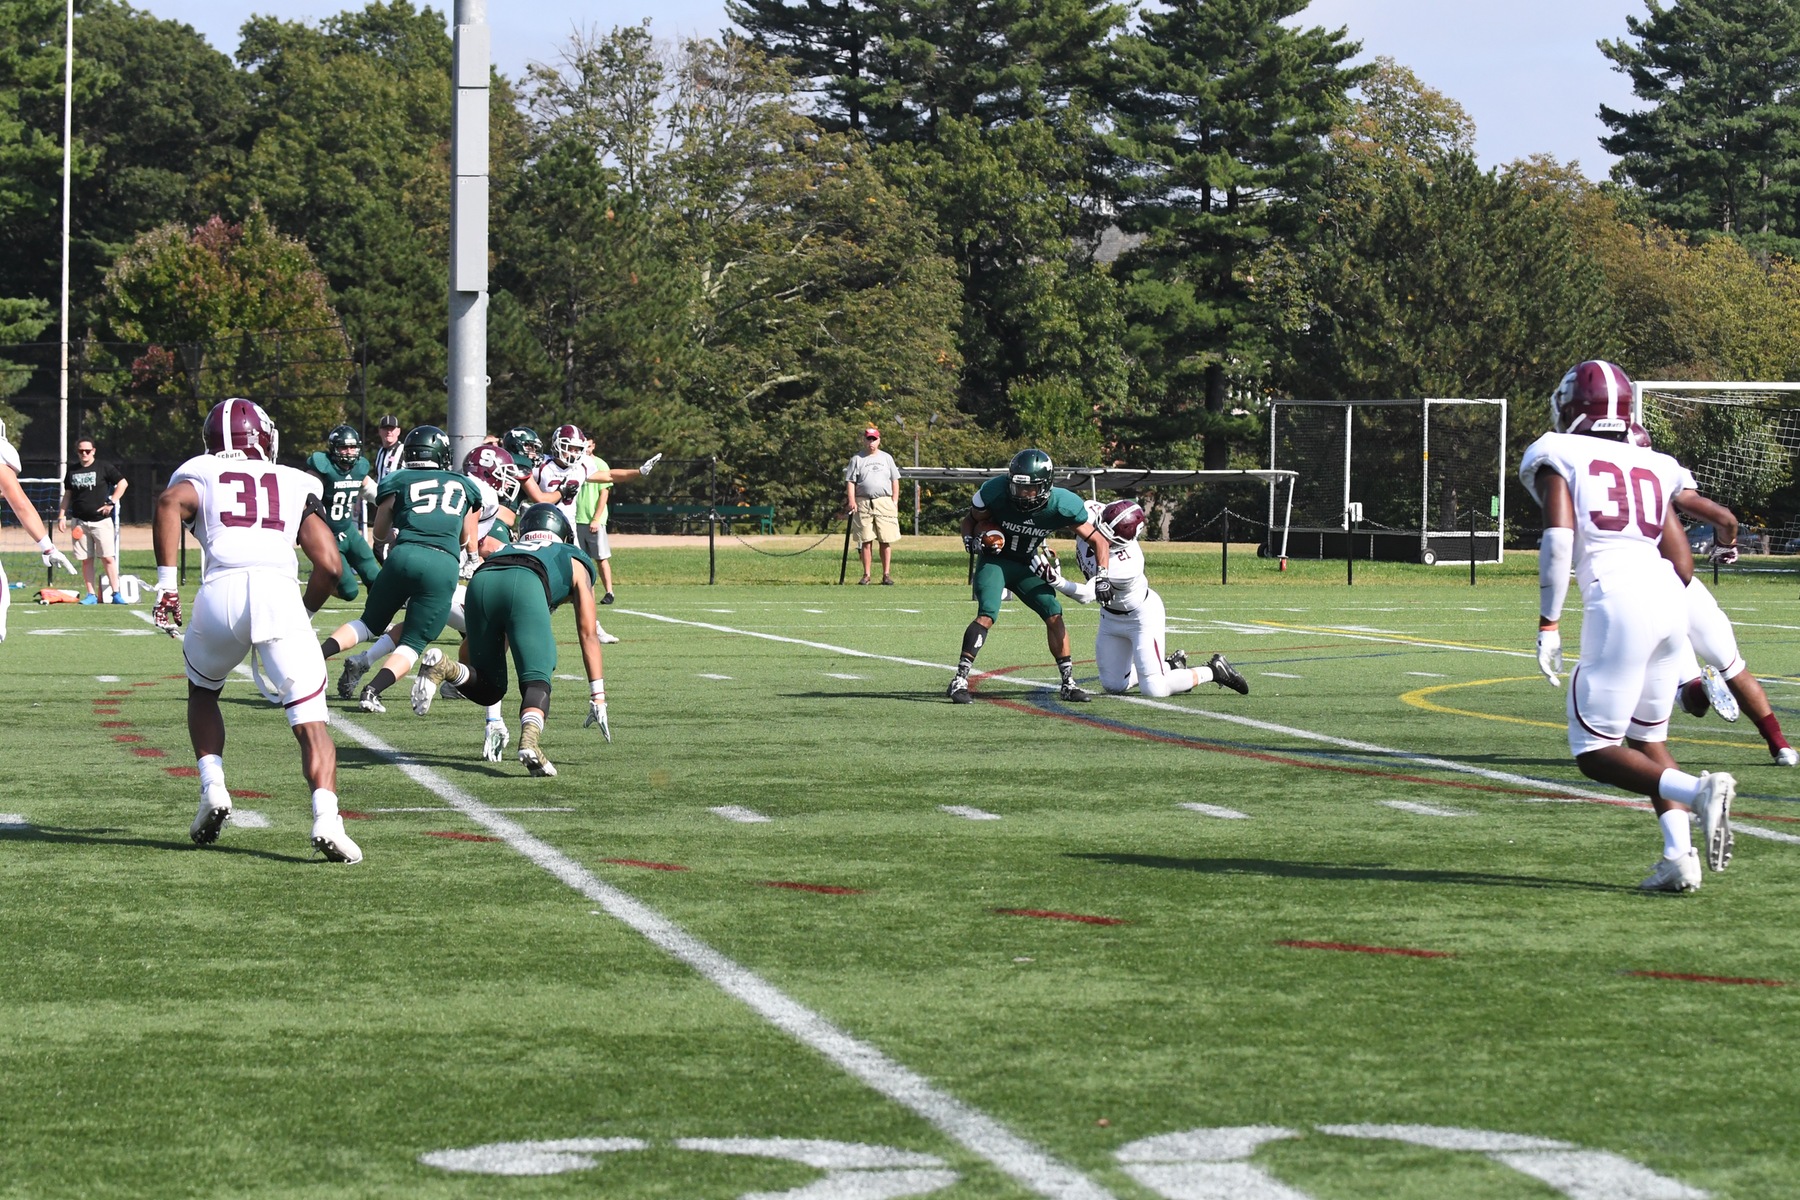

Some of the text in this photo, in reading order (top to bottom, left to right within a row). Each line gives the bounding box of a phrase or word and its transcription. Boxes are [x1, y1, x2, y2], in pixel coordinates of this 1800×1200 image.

[219, 471, 285, 532] 31
[410, 479, 466, 516] 50
[1589, 459, 1663, 540] 30
[524, 532, 553, 541] Riddell
[1115, 549, 1131, 561] 21
